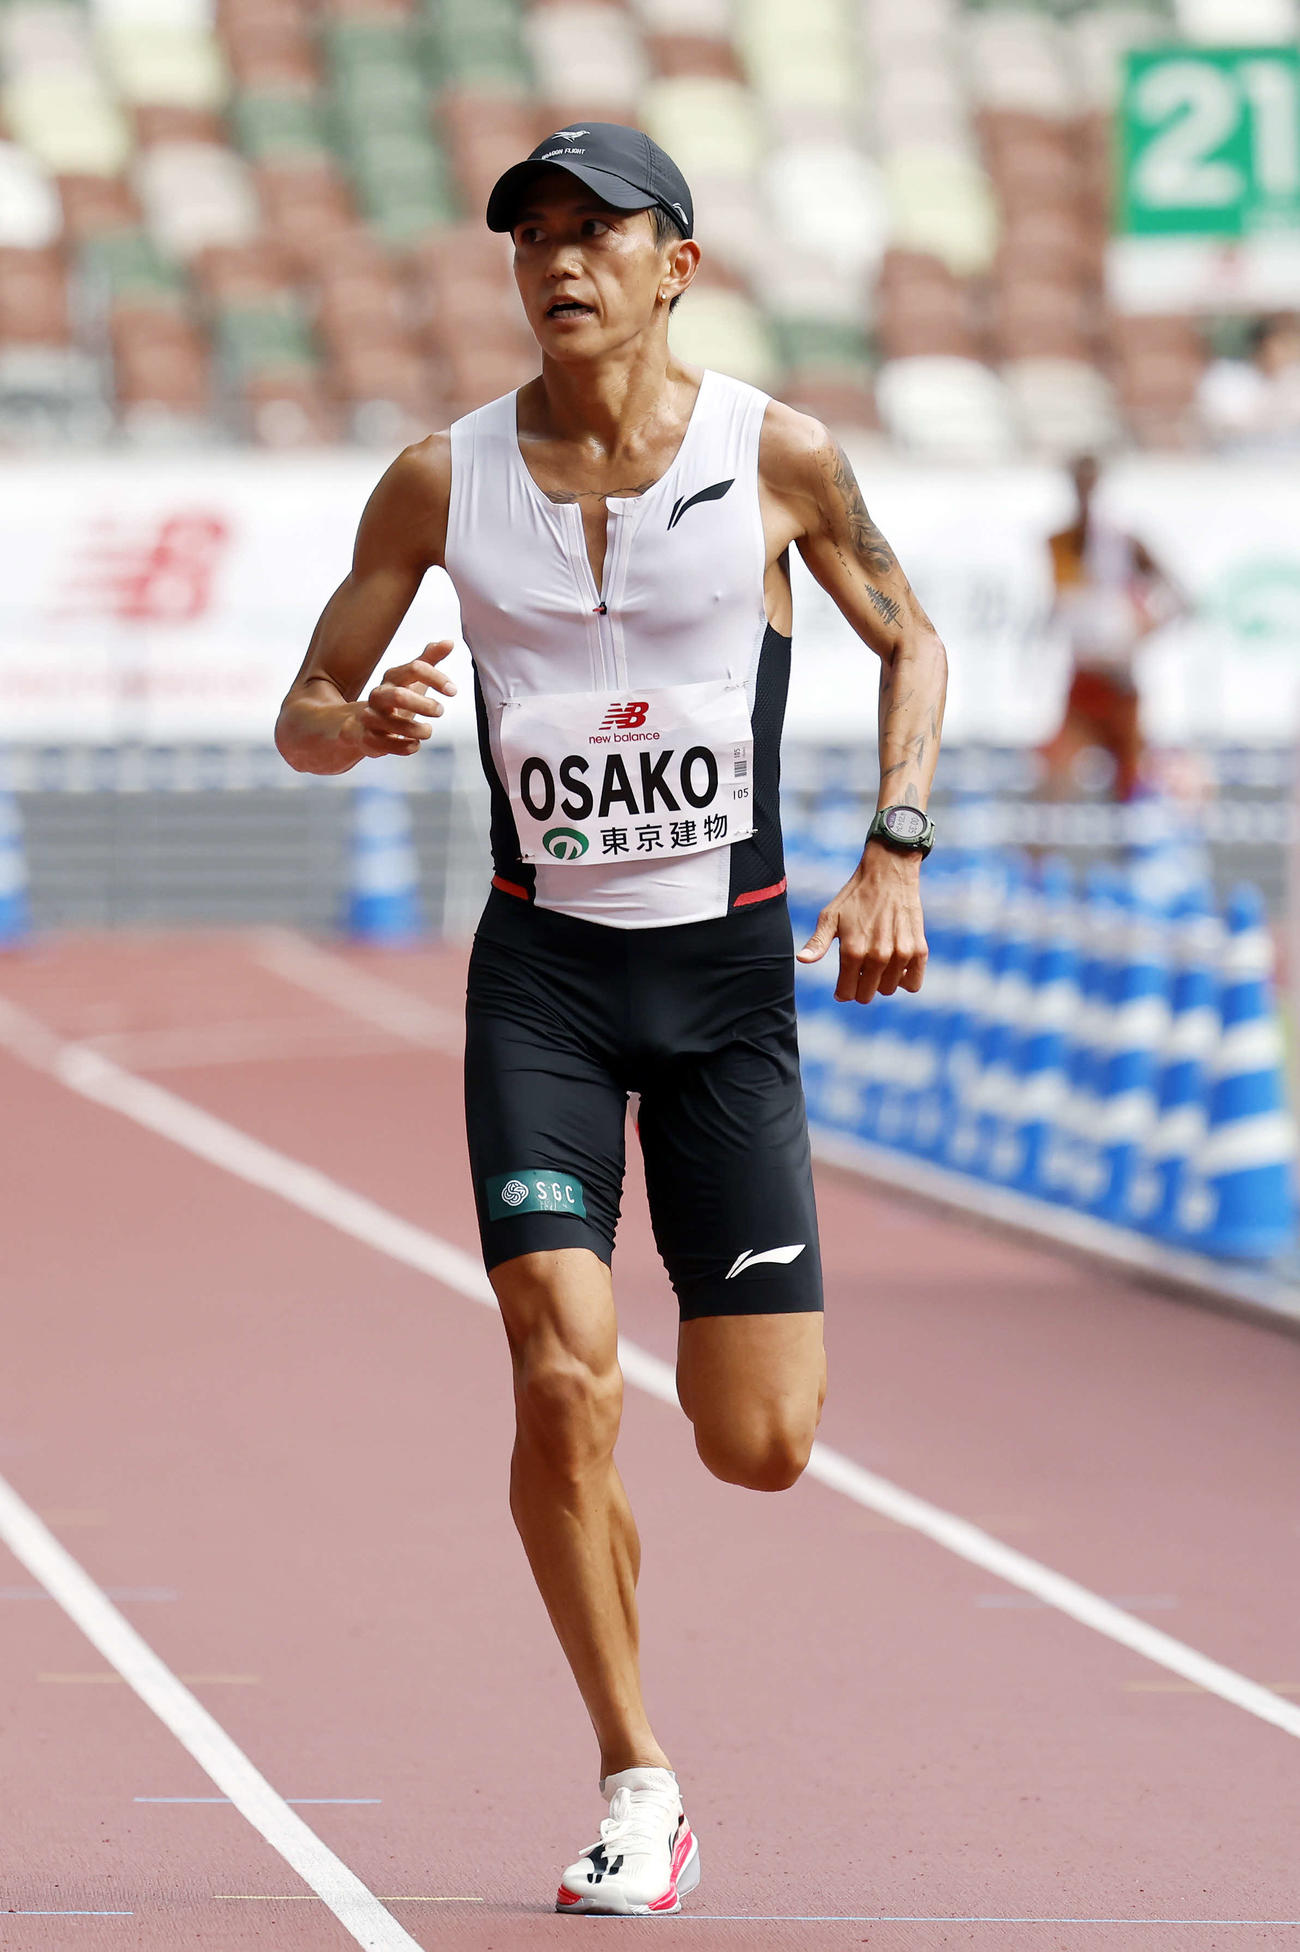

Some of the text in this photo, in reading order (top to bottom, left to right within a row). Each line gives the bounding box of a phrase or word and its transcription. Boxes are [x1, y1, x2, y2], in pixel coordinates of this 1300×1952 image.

[1133, 59, 1299, 208] 21
[588, 730, 661, 745] new balance
[520, 746, 719, 821] OSAKO
[733, 787, 749, 801] 105
[600, 813, 728, 856] 東京建物
[536, 1181, 575, 1204] SGC
